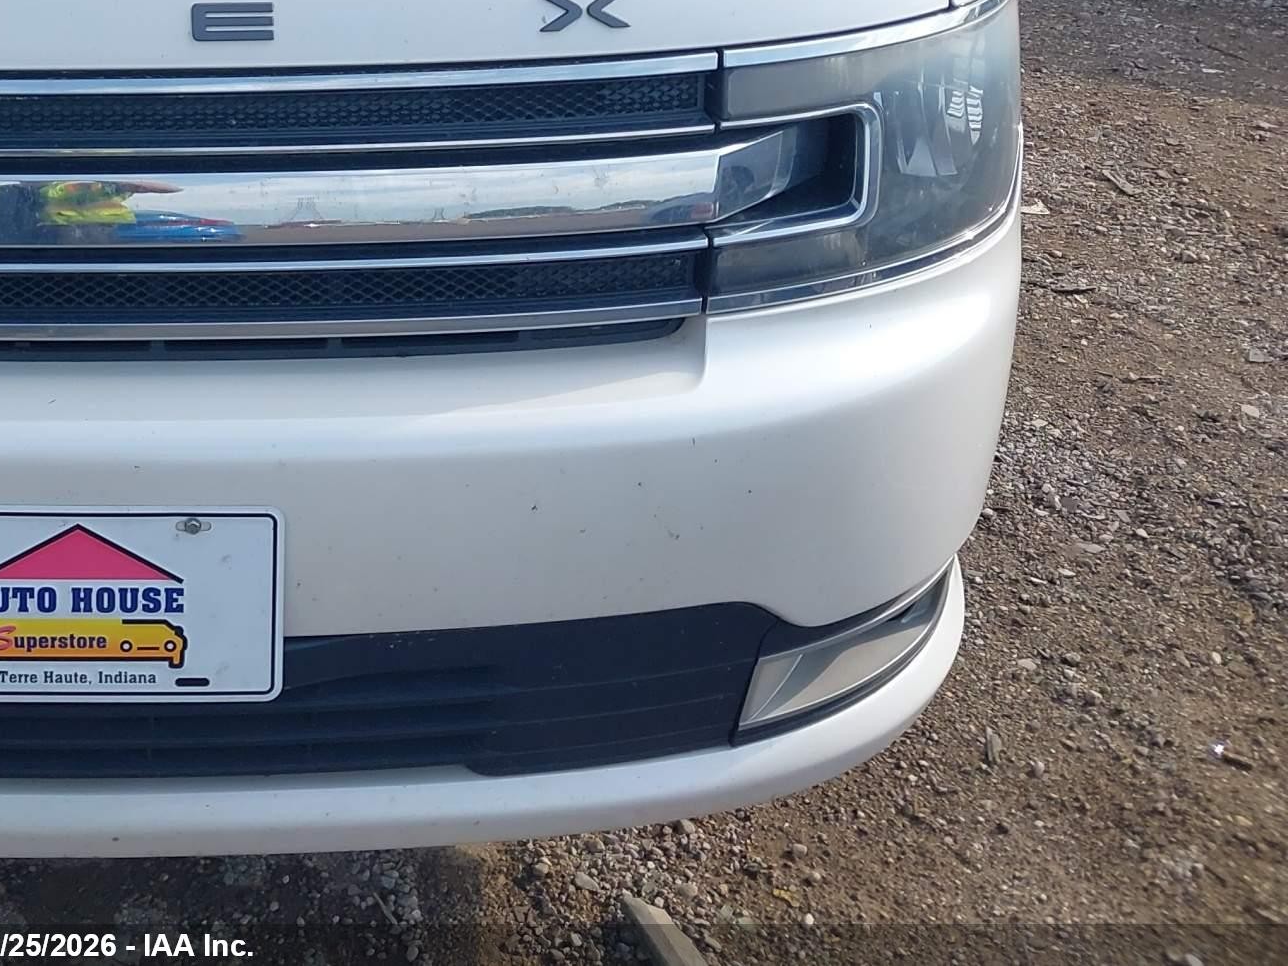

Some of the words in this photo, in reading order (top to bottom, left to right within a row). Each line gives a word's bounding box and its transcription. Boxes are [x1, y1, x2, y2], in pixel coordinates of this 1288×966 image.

[71, 587, 184, 614] HOUSE
[43, 671, 93, 685] Haute,
[98, 671, 157, 684] Indiana
